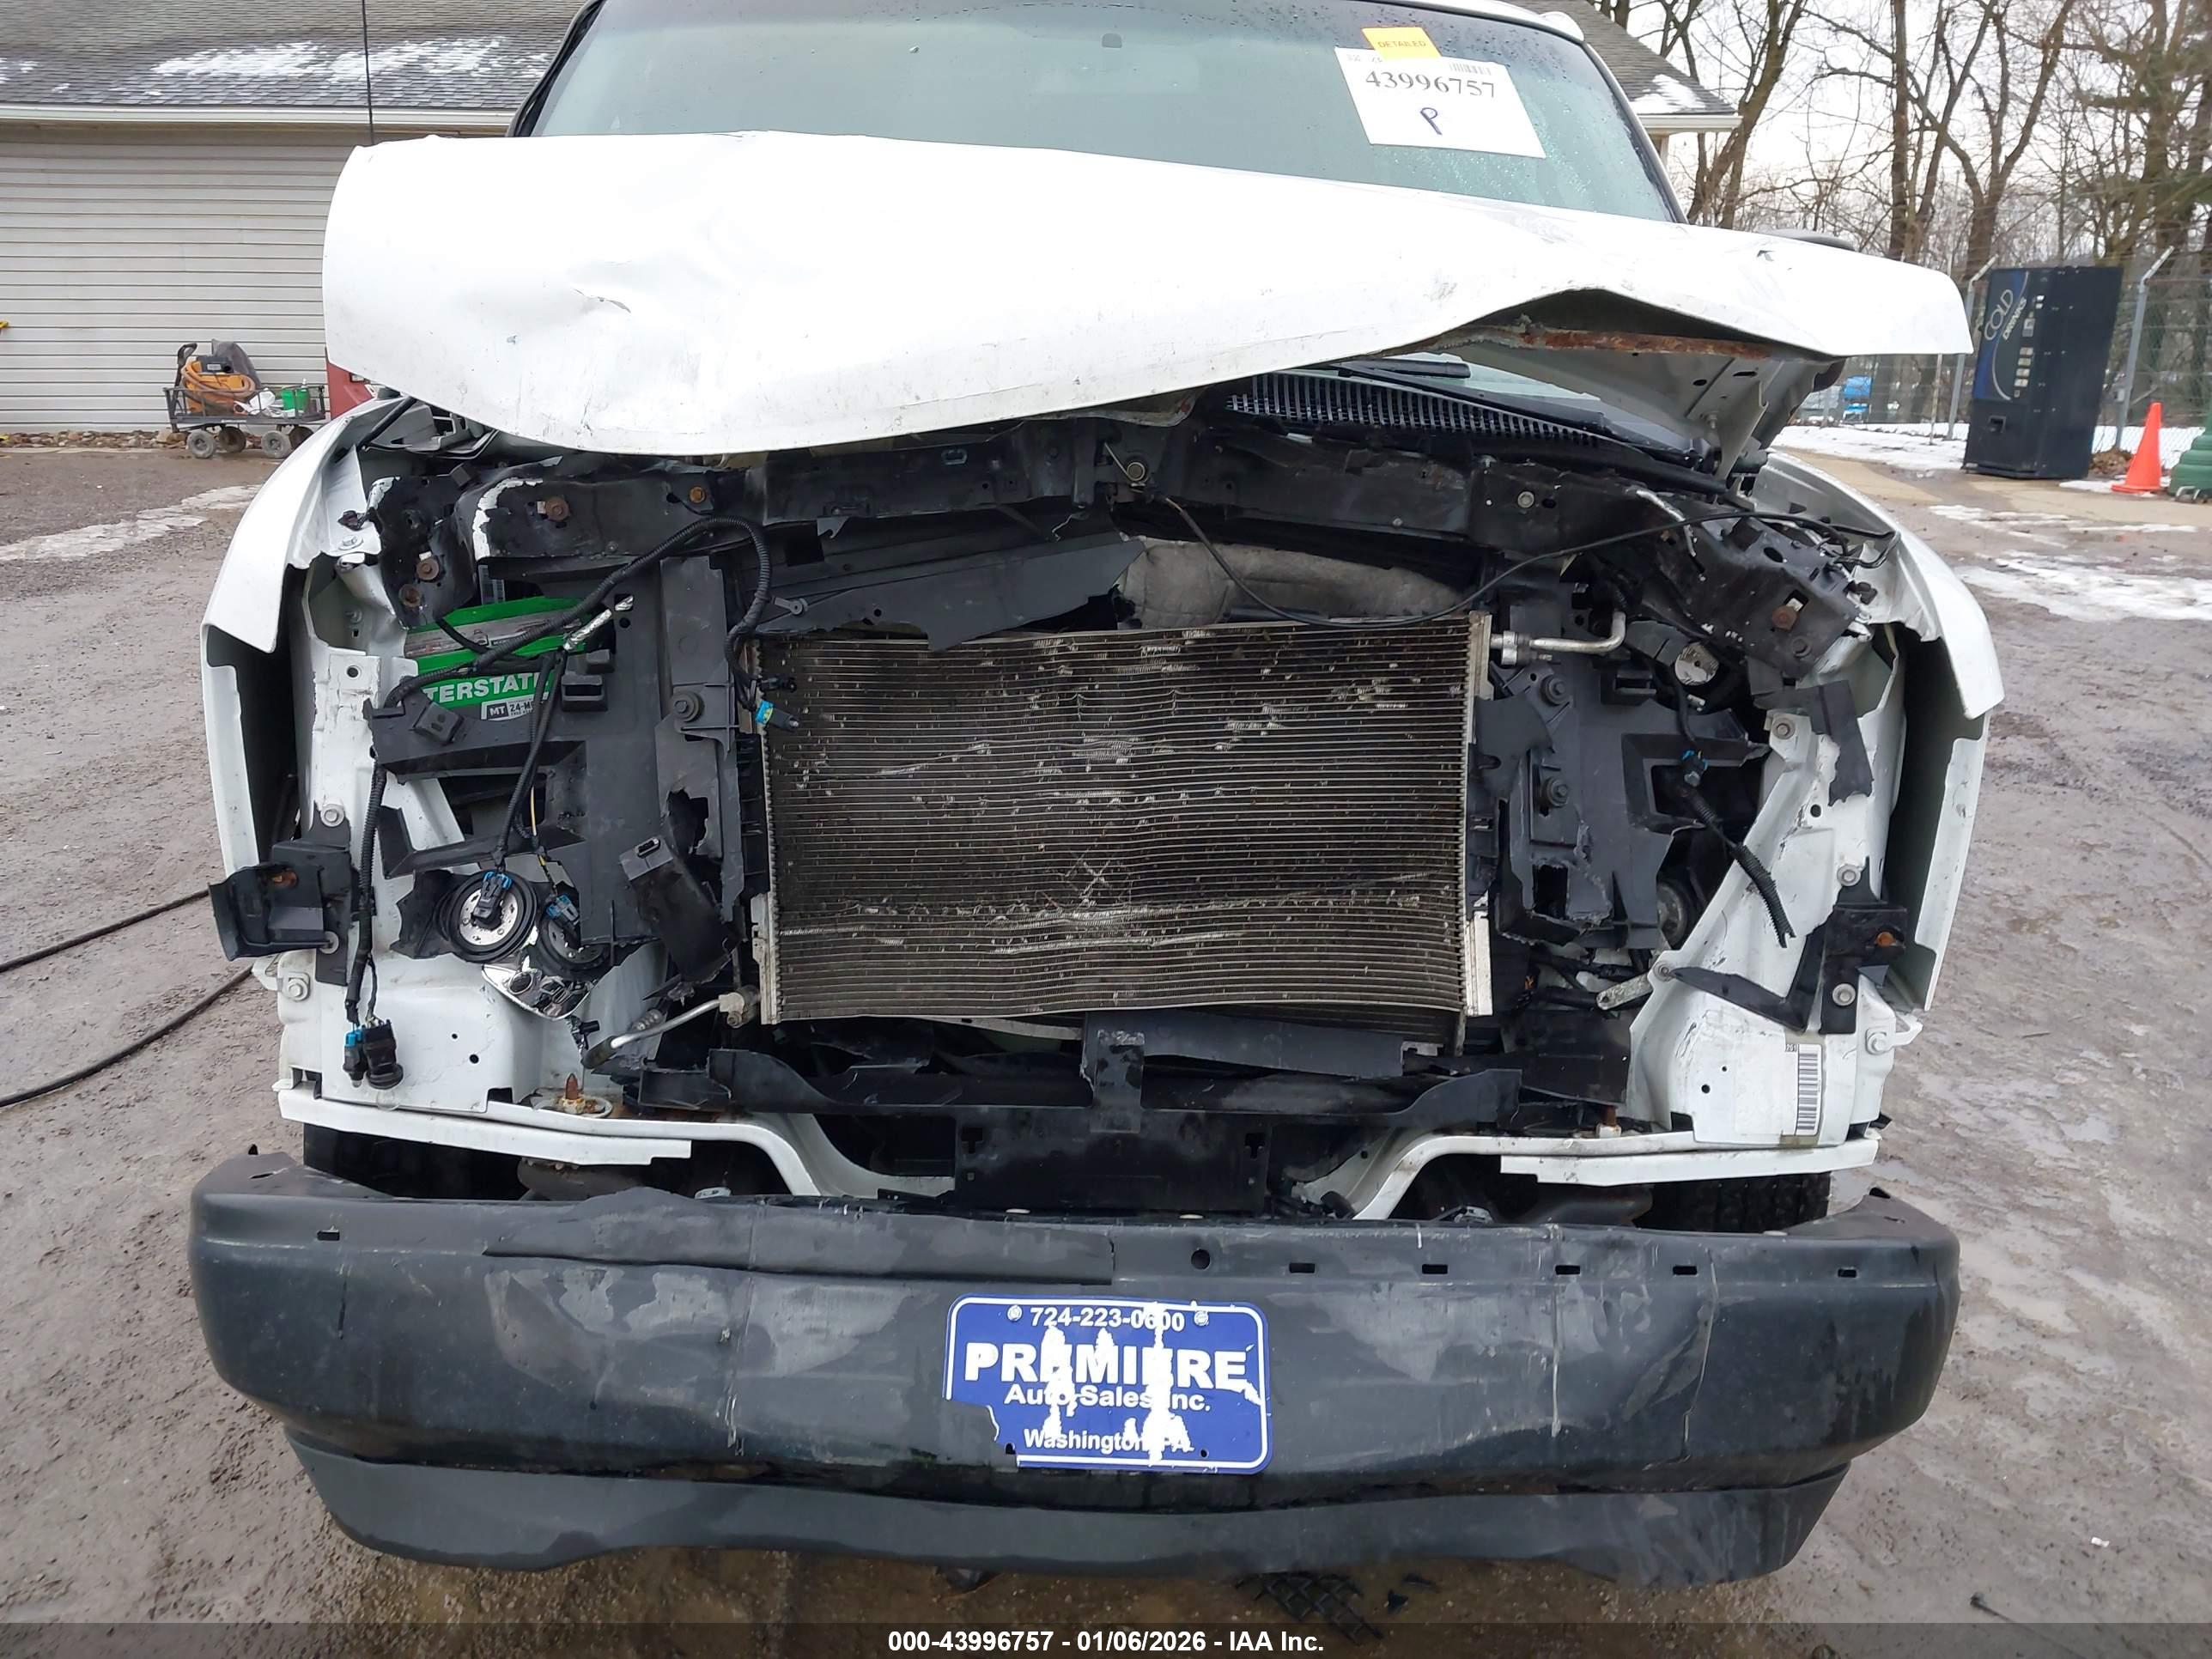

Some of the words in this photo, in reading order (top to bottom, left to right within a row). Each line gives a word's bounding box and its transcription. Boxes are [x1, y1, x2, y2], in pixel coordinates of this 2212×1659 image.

[1365, 71, 1494, 98] 43996757
[1984, 289, 2014, 340] COLD
[489, 706, 505, 716] MT
[1030, 1307, 1185, 1332] 724-223-0600
[1079, 1386, 1152, 1409] Sales
[1163, 1391, 1212, 1412] nc.
